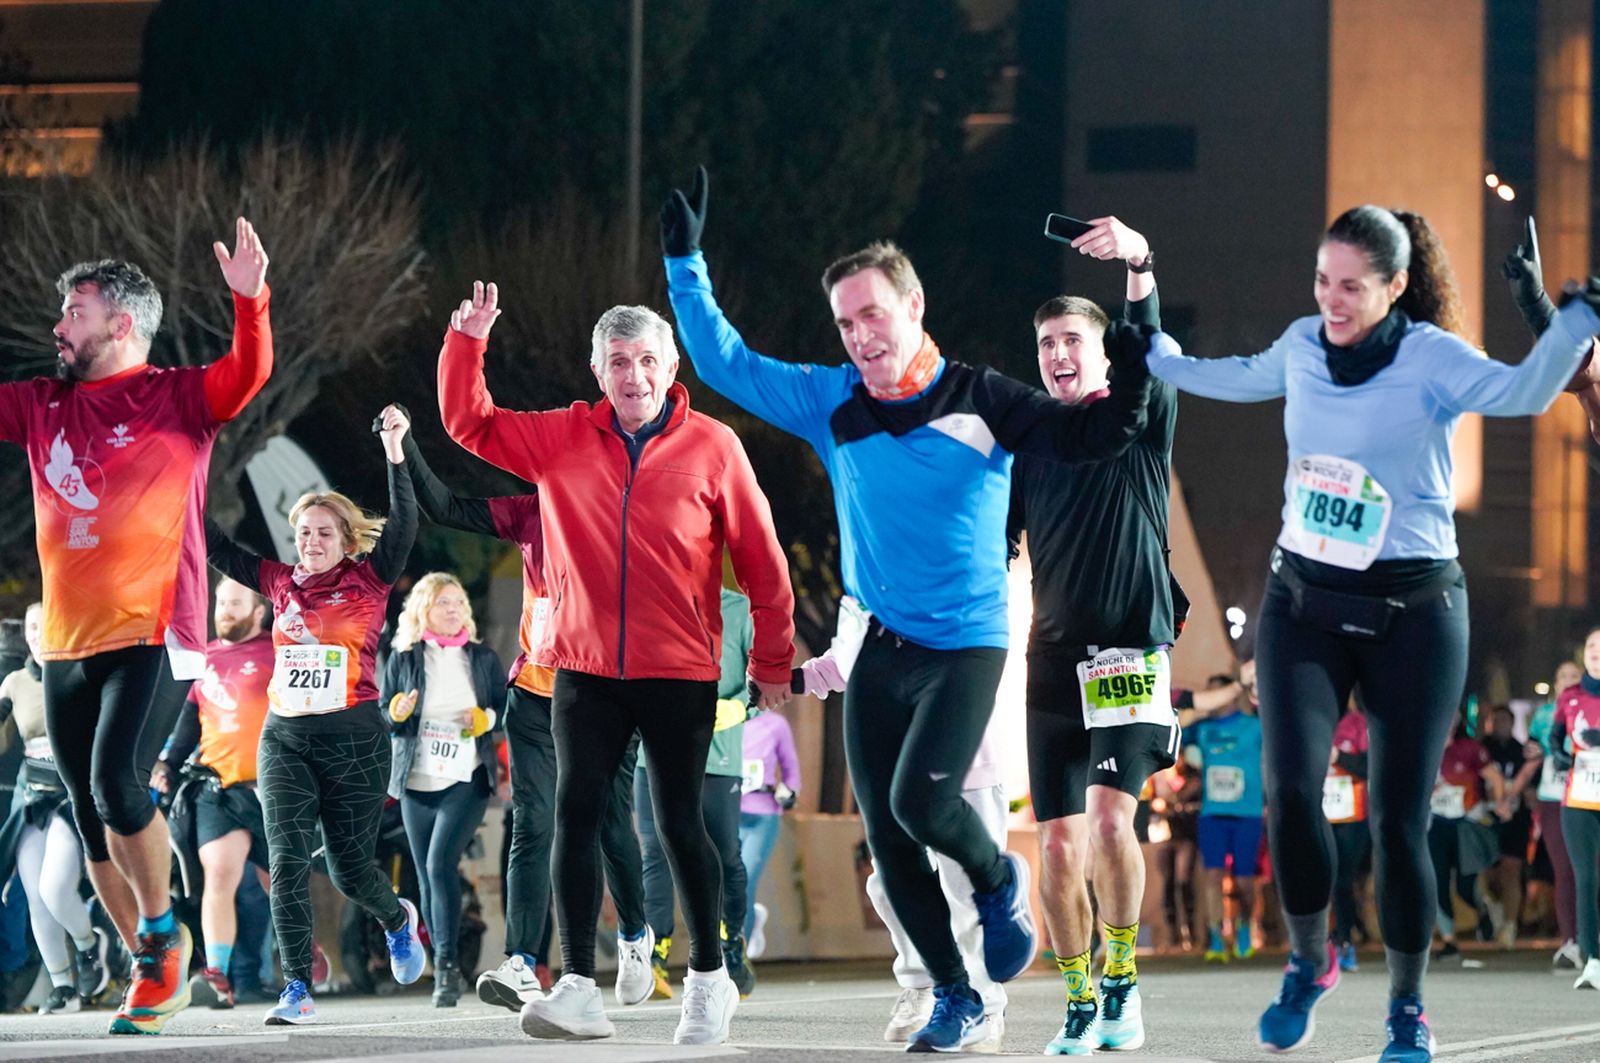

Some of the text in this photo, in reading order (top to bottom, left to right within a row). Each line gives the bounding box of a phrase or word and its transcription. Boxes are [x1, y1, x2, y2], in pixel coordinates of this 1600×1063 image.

[59, 473, 81, 497] 43
[285, 619, 304, 639] 43
[1096, 656, 1136, 667] NOCHE DE
[1088, 668, 1106, 680] SAN
[1108, 665, 1138, 676] ANTON
[1097, 673, 1156, 700] 4965
[430, 740, 459, 759] 907
